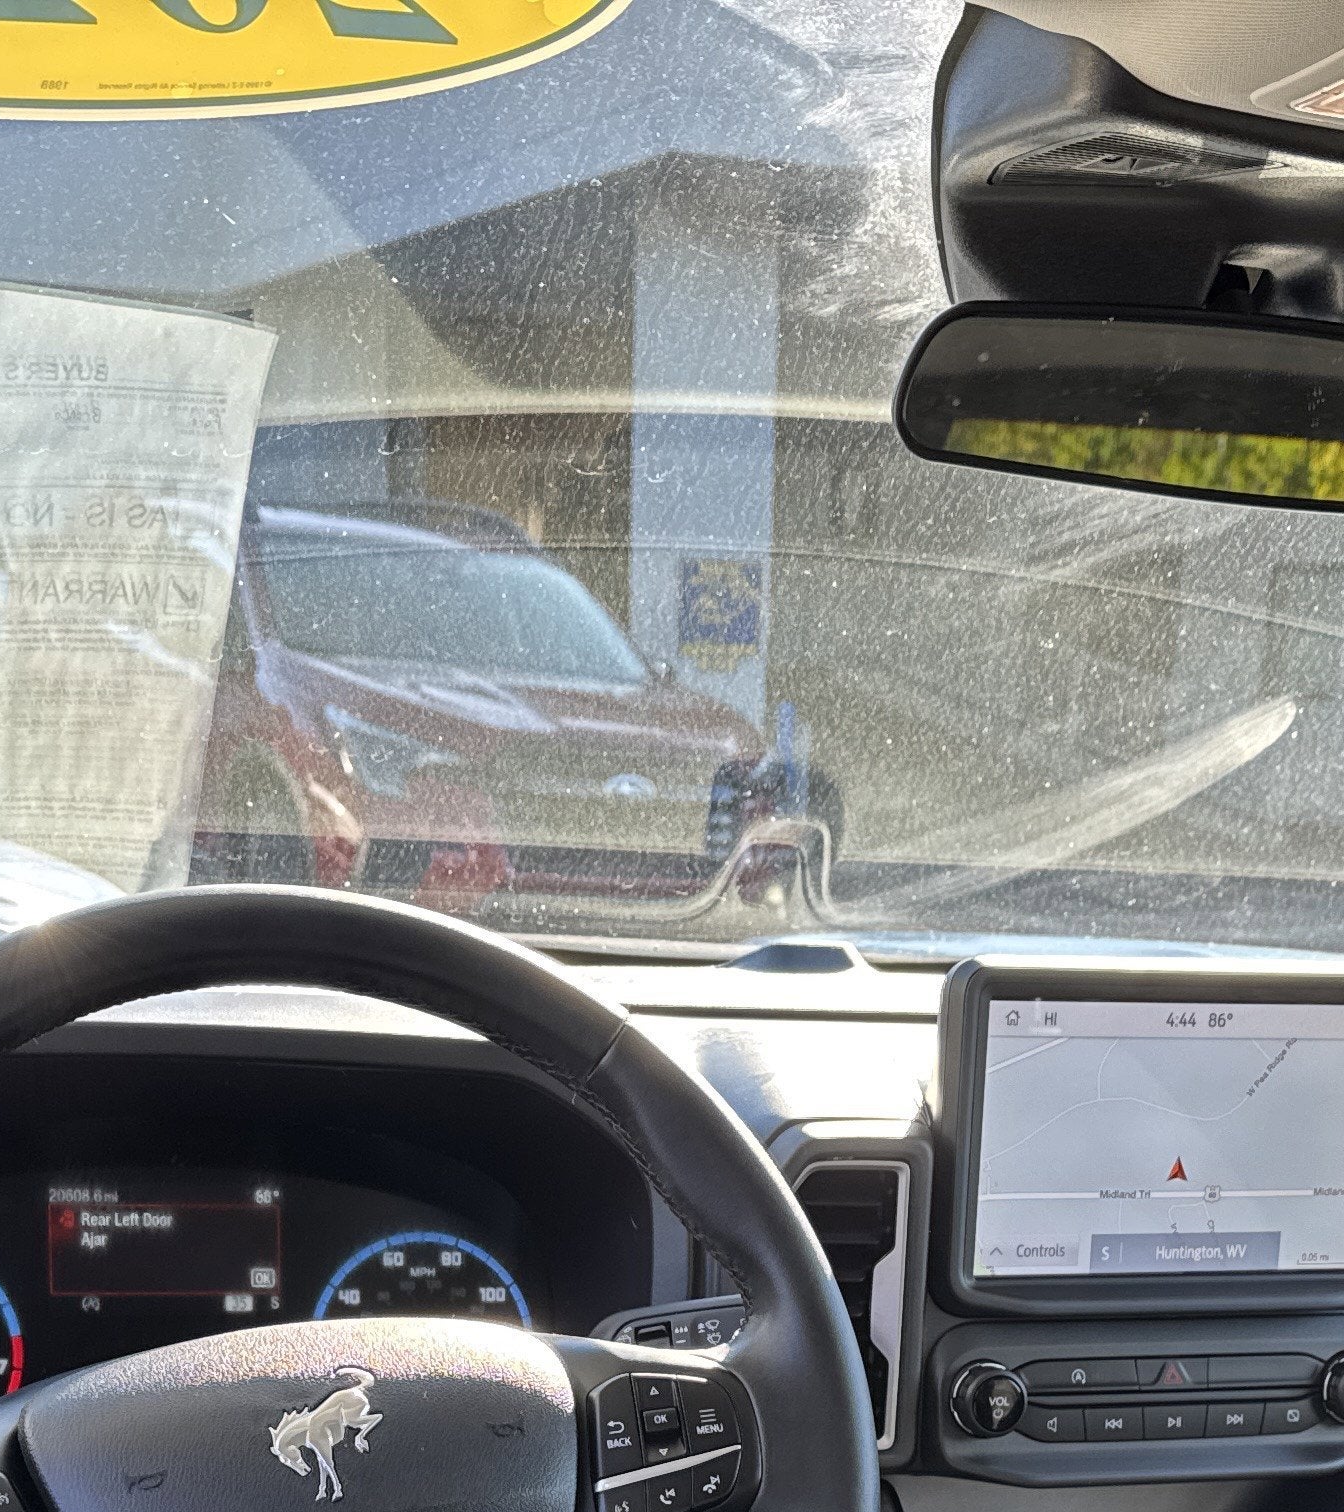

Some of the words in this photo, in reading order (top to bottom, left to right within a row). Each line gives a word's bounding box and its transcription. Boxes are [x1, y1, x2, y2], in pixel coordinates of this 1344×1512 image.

[1165, 1013, 1197, 1028] 4:44
[1208, 1012, 1234, 1028] 86°
[1099, 1189, 1136, 1199] Midland
[81, 1212, 112, 1226] Rear
[114, 1211, 140, 1226] Left
[142, 1211, 174, 1227] Door
[81, 1232, 108, 1249] Ajar
[1016, 1244, 1066, 1258] Controls
[1156, 1244, 1223, 1261] Huntington,
[1226, 1244, 1247, 1258] WV
[382, 1251, 404, 1267] 60
[441, 1251, 462, 1267] 80
[410, 1268, 436, 1277] MPH
[337, 1287, 361, 1305] 40
[479, 1287, 506, 1302] 100
[988, 1396, 1010, 1407] VOL
[653, 1414, 668, 1424] OK
[696, 1423, 724, 1435] MENU
[606, 1437, 632, 1449] BACK
